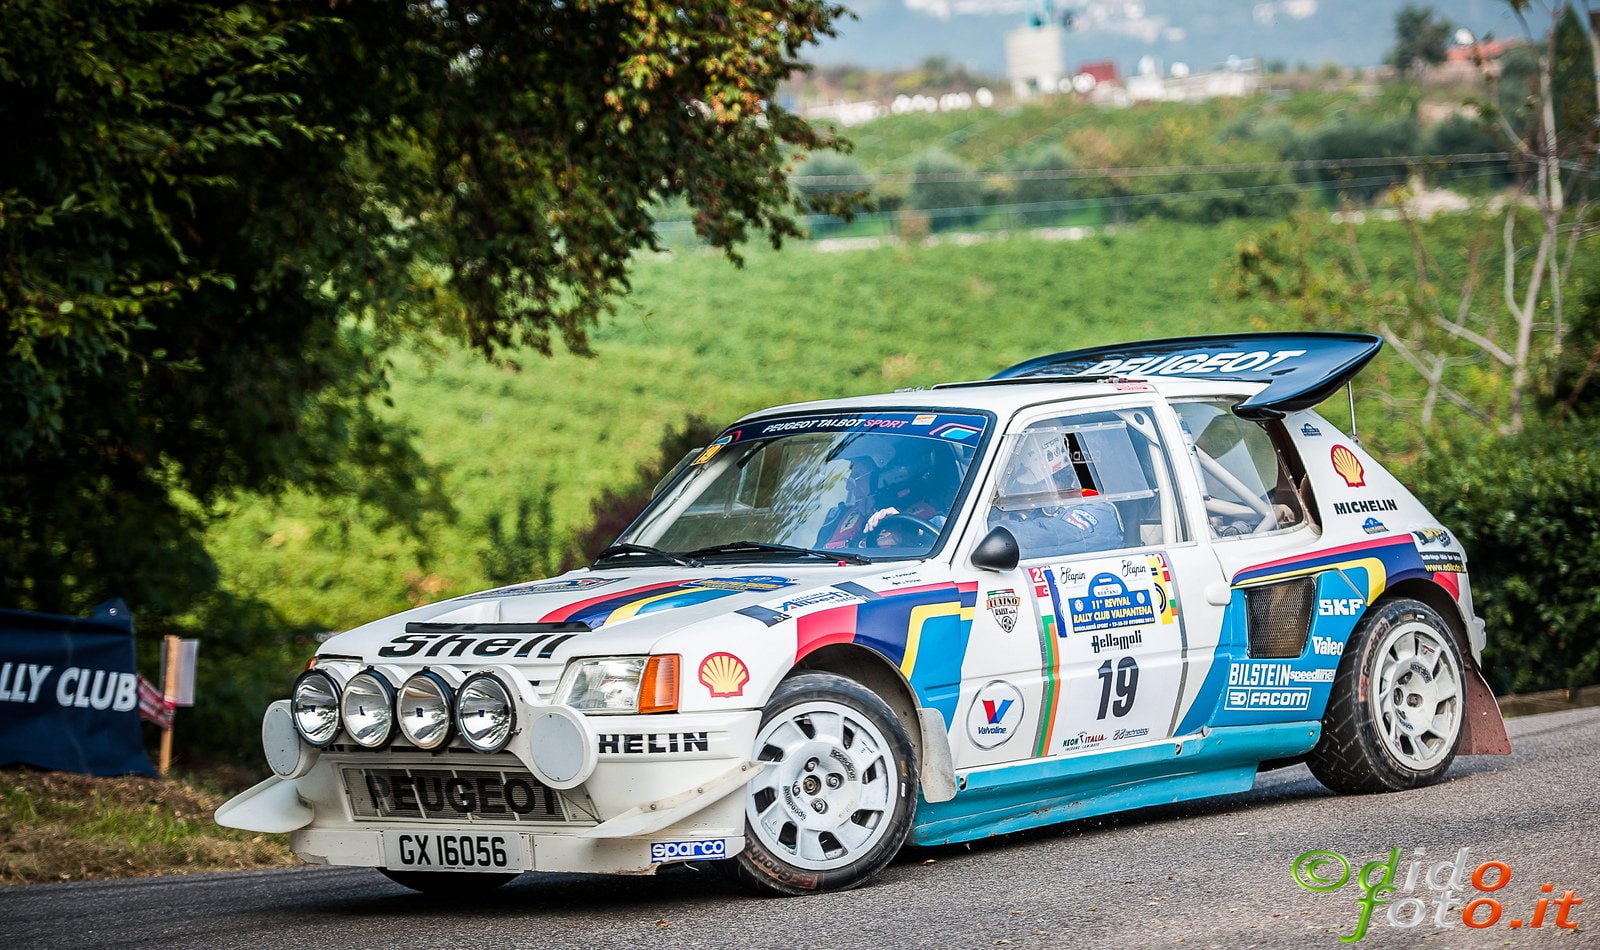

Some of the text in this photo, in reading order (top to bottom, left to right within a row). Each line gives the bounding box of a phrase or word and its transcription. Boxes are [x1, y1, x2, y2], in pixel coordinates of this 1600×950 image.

[1081, 350, 1307, 376] PEUGEOT
[762, 419, 819, 433] PEUGEOT
[817, 418, 866, 428] TALBOT
[864, 419, 908, 429] SPORT
[1333, 499, 1398, 515] MICHELIN
[1060, 566, 1086, 584] Scapin
[1121, 559, 1147, 577] Scapin
[1104, 596, 1131, 608] REVIVAL
[1319, 598, 1363, 616] SKF
[1073, 605, 1153, 624] RALLY CLUB VALPANTENA
[377, 634, 578, 659] Shell
[1091, 630, 1142, 653] Bellamoli
[1312, 636, 1343, 656] Valeo
[1228, 663, 1336, 686] BILSTEIN speedline
[56, 666, 138, 712] CLUB
[1096, 656, 1139, 721] 19
[1250, 692, 1307, 706] FACOM
[978, 726, 1007, 735] Valvoline
[1085, 734, 1105, 744] ITALIA
[598, 731, 708, 754] HELIN
[366, 774, 556, 815] PEUGEOT
[399, 835, 507, 867] GX 16056
[652, 840, 725, 862] sparco
